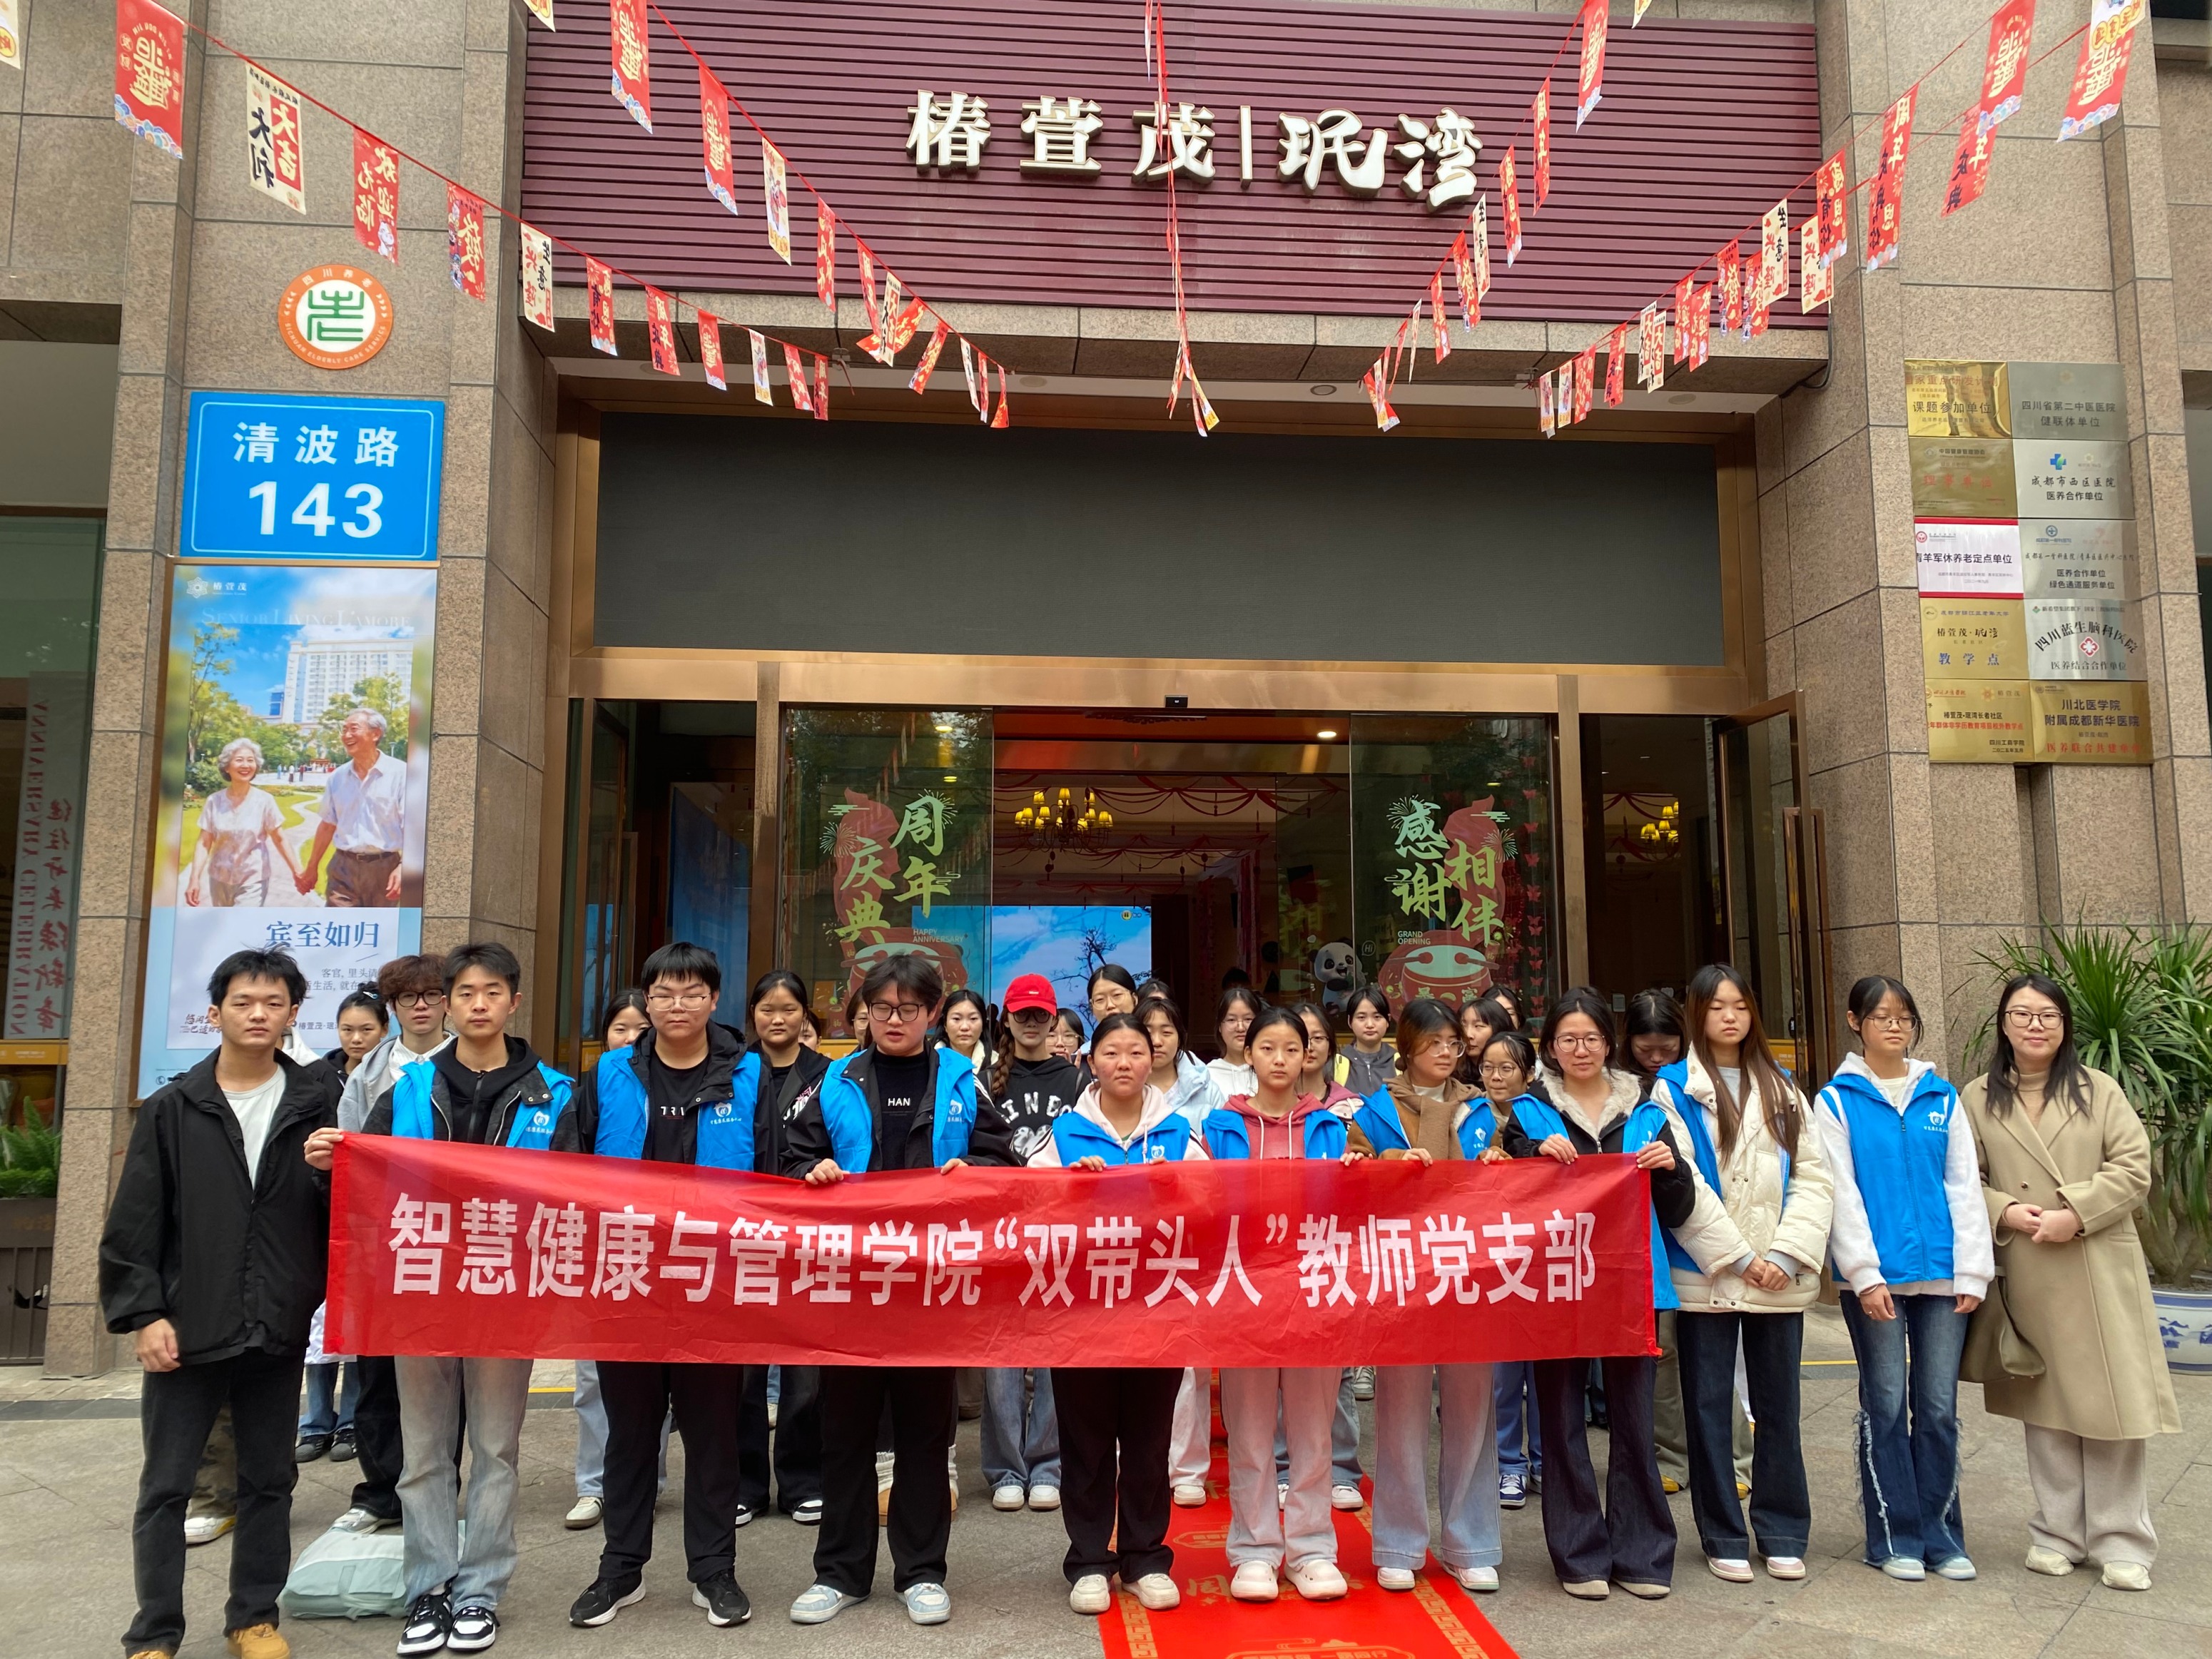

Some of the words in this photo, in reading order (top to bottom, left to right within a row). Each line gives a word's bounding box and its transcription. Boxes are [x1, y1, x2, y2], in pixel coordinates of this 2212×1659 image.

[285, 323, 307, 352] SICHUAN
[307, 351, 340, 364] ELDERLY
[344, 351, 364, 362] CARE
[365, 325, 386, 352] SERVICE
[1913, 401, 1992, 414] 课题参加单位
[2021, 400, 2116, 412] 四川省第二中医医院
[2041, 416, 2101, 427] 健联体单位
[233, 421, 400, 467] 清波路
[2031, 475, 2116, 488] 成都市西区医院
[2046, 491, 2104, 501] 医养合作单位
[248, 480, 384, 538] 143
[2056, 569, 2106, 579] 医养合作单位
[2049, 580, 2116, 589] 绿色通道服务单位
[2034, 621, 2139, 654] 四川蓝生脑科医院
[1939, 652, 1999, 666] 教学点
[2051, 661, 2128, 671] 医养结合合作单位
[2062, 699, 2121, 711] 川北医学院
[2044, 714, 2141, 727] 附属成都新华医院
[890, 794, 950, 918] 周年
[1391, 798, 1453, 922] 感谢
[835, 836, 896, 944] 庆典
[1444, 838, 1505, 948] 相伴
[265, 920, 380, 948] 宾至如归
[888, 1097, 910, 1107] HAN
[388, 1192, 1597, 1309] 智慧健康与管理学院“双带头人”教师党支部
